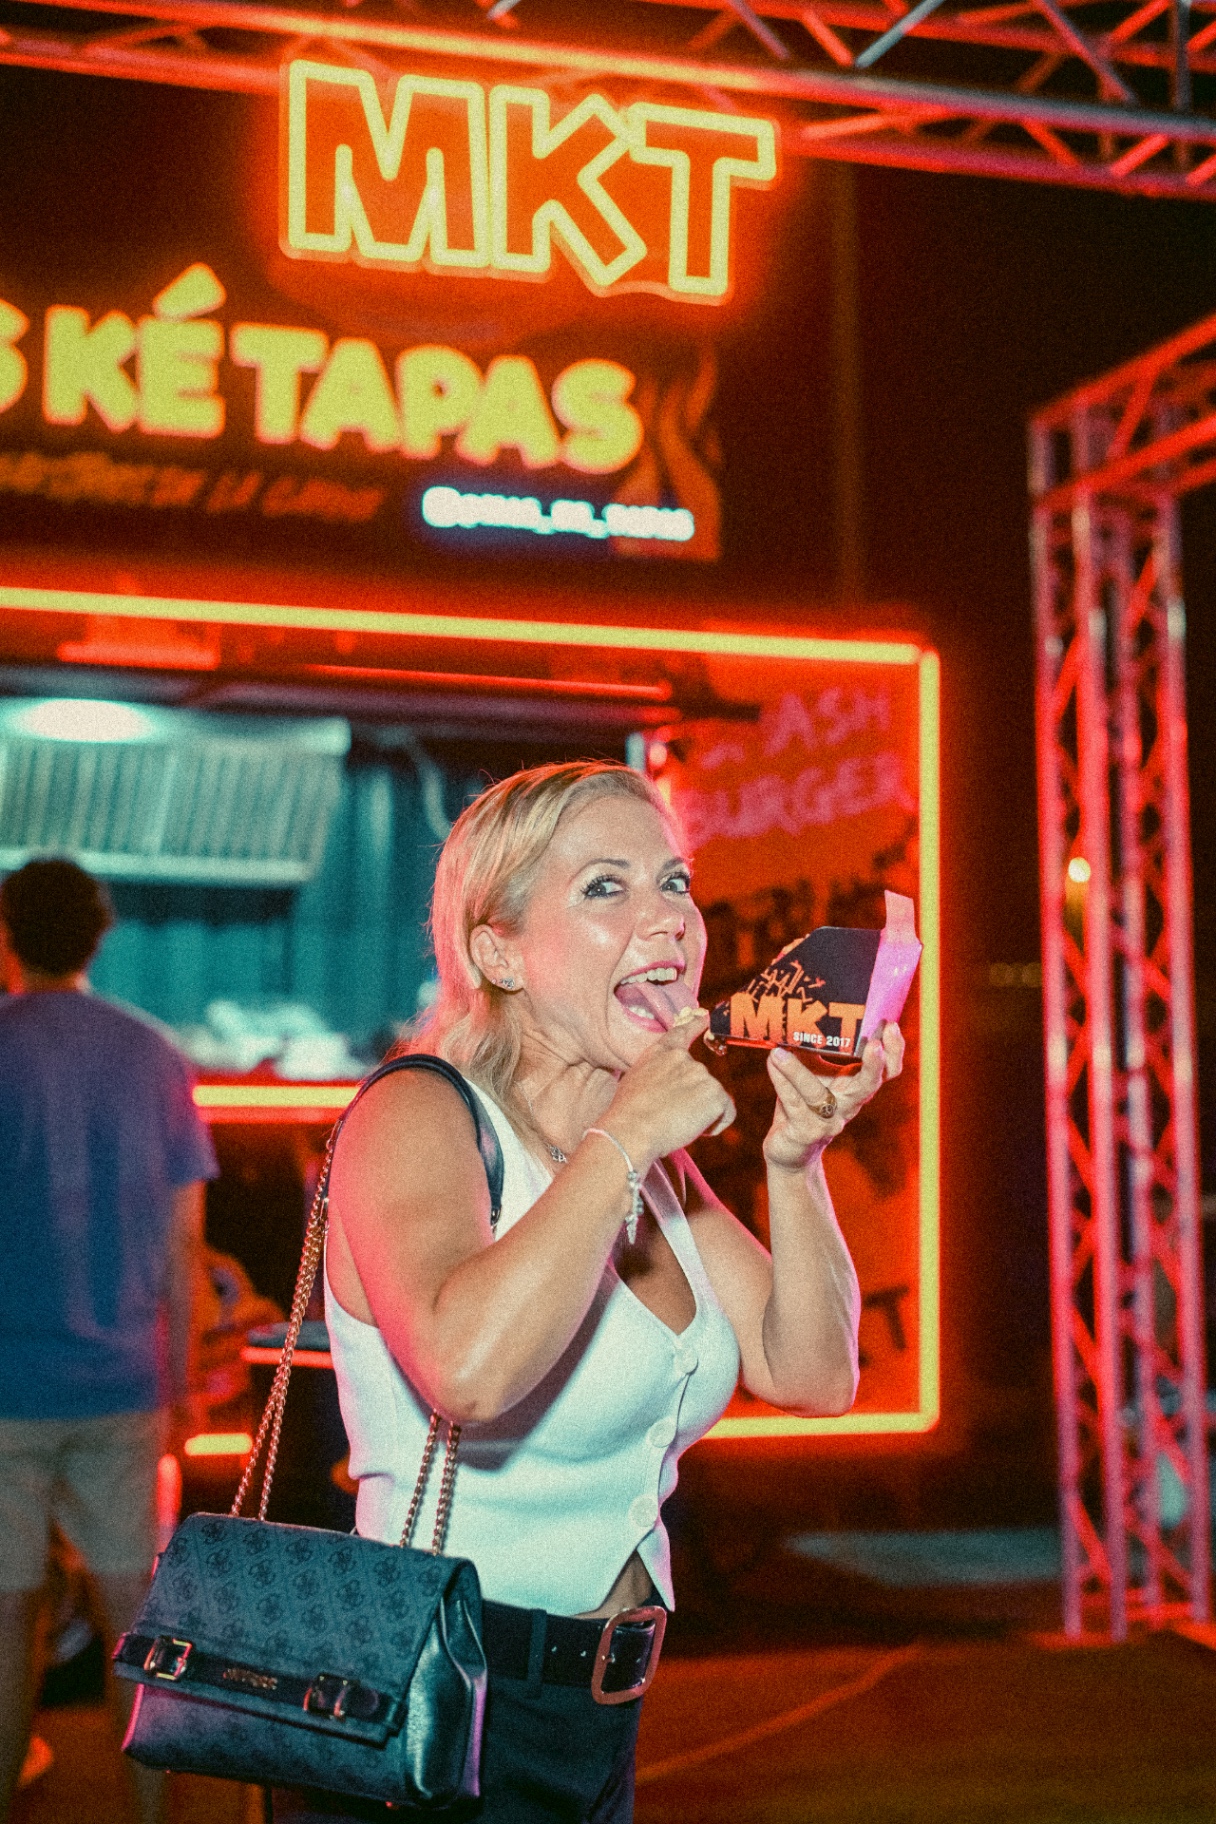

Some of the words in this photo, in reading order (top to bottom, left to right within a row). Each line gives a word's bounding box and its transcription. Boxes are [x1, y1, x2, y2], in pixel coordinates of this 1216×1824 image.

[282, 58, 778, 304] MKT
[43, 262, 227, 439] KÉ
[230, 321, 644, 474] TAPAS
[730, 991, 866, 1055] MKT
[793, 1031, 823, 1045] SINCE
[826, 1035, 851, 1048] 2017
